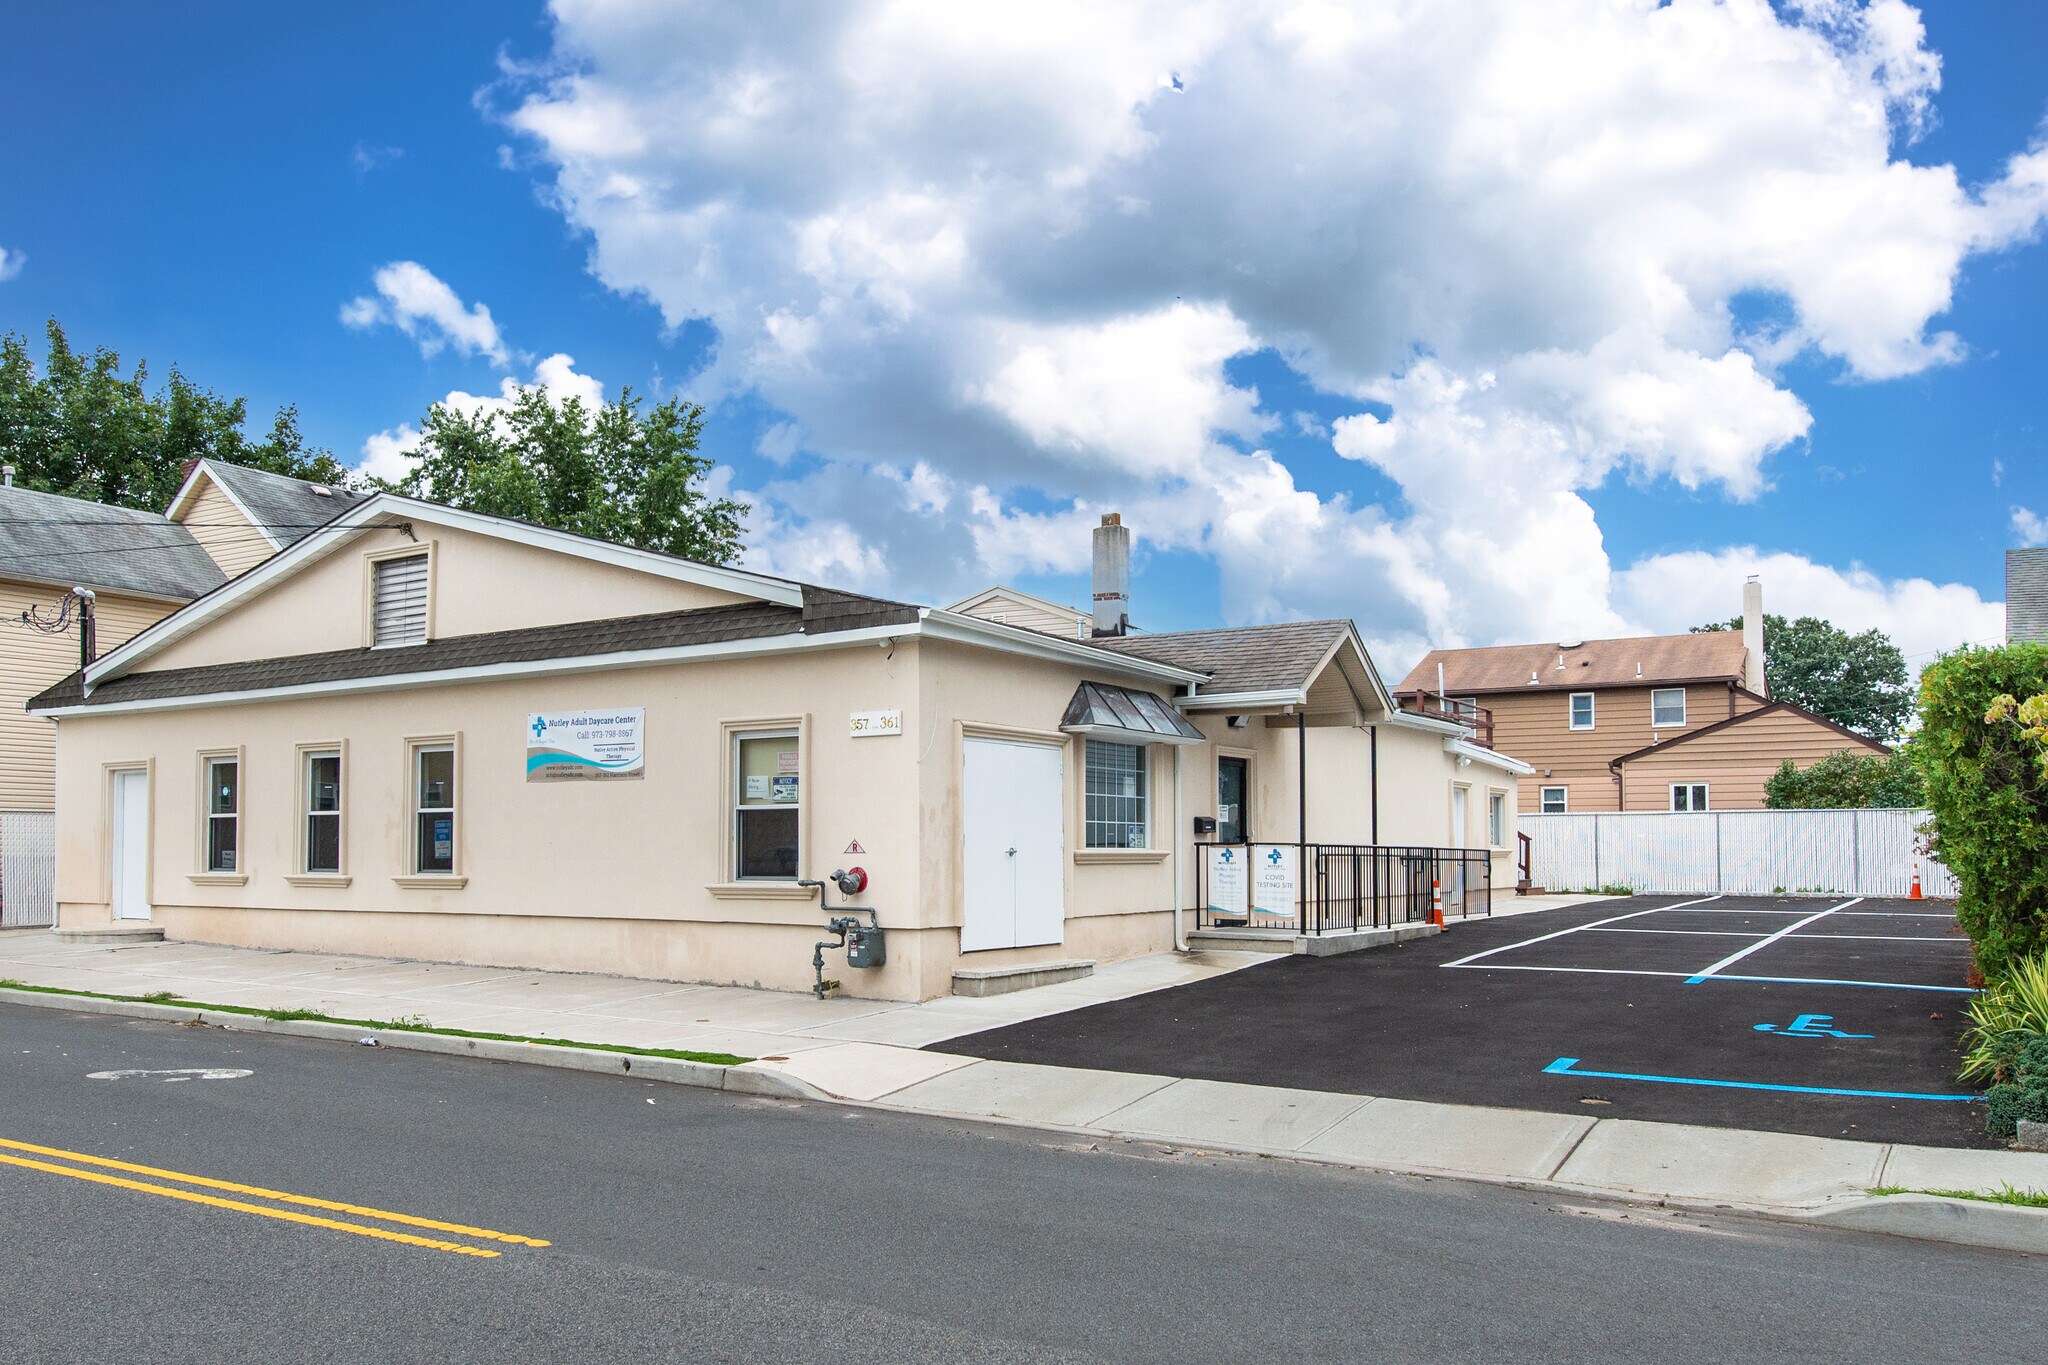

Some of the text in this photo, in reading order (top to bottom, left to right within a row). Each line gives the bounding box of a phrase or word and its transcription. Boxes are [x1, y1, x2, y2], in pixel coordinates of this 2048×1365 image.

[548, 716, 636, 728] Nutley Adult Daycare Center
[851, 718, 869, 730] 357
[880, 716, 899, 729] 361
[852, 844, 857, 852] R
